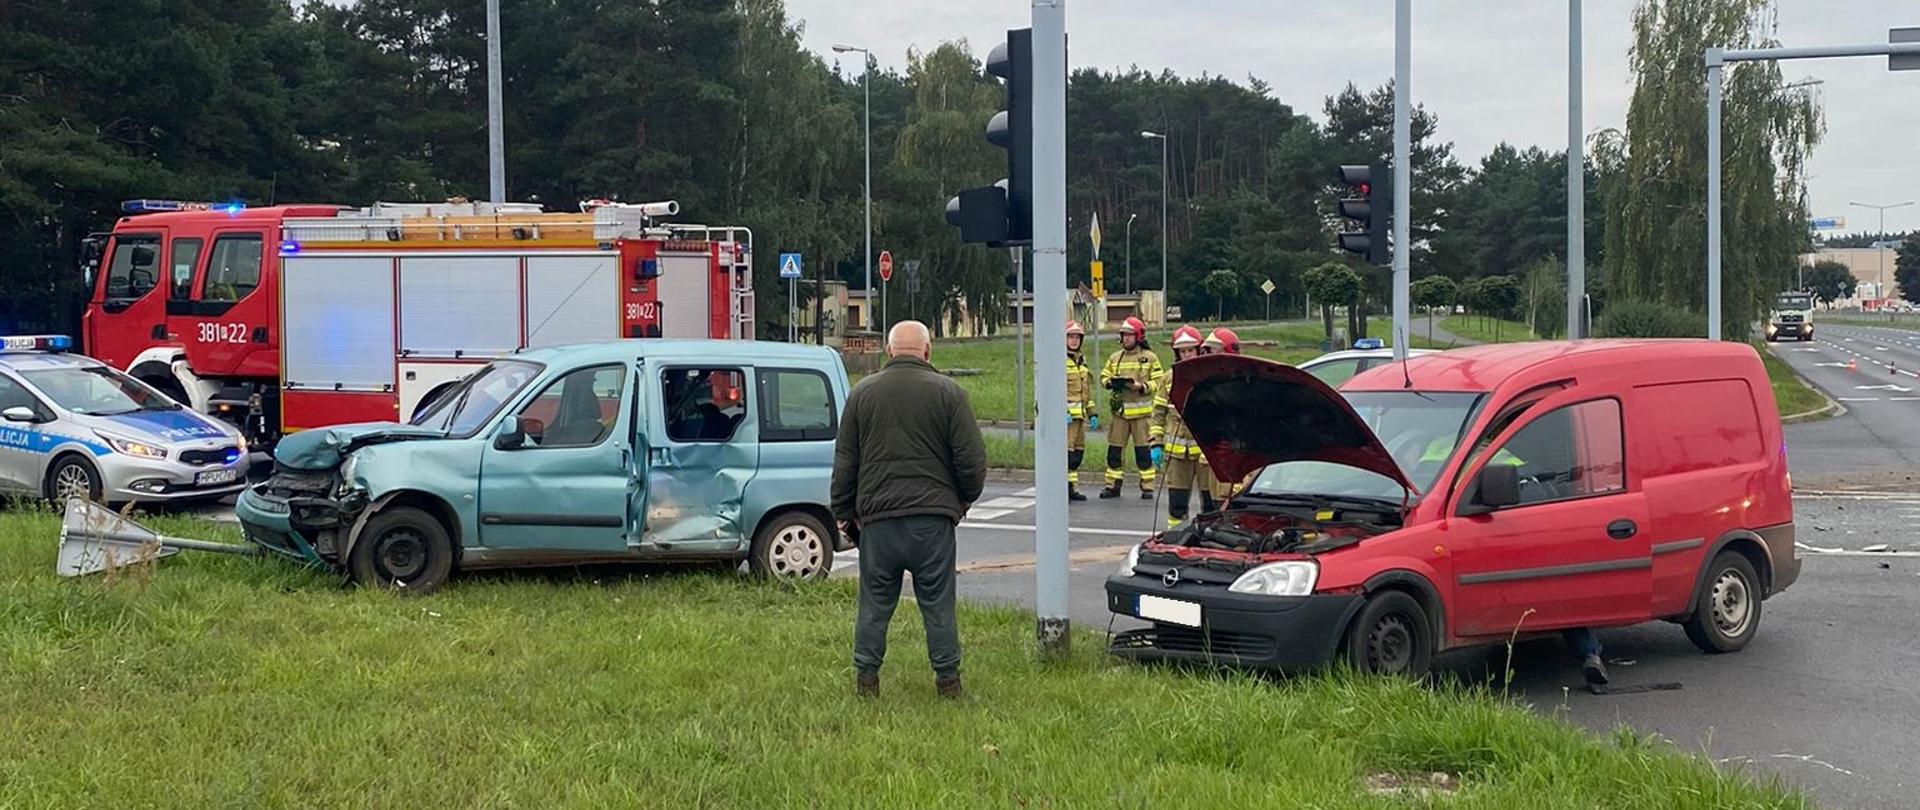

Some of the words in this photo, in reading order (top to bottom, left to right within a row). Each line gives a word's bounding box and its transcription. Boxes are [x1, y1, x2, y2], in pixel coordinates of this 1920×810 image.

[5, 338, 35, 348] POLICJA
[0, 428, 29, 447] LICJA
[160, 426, 218, 438] POLICJA
